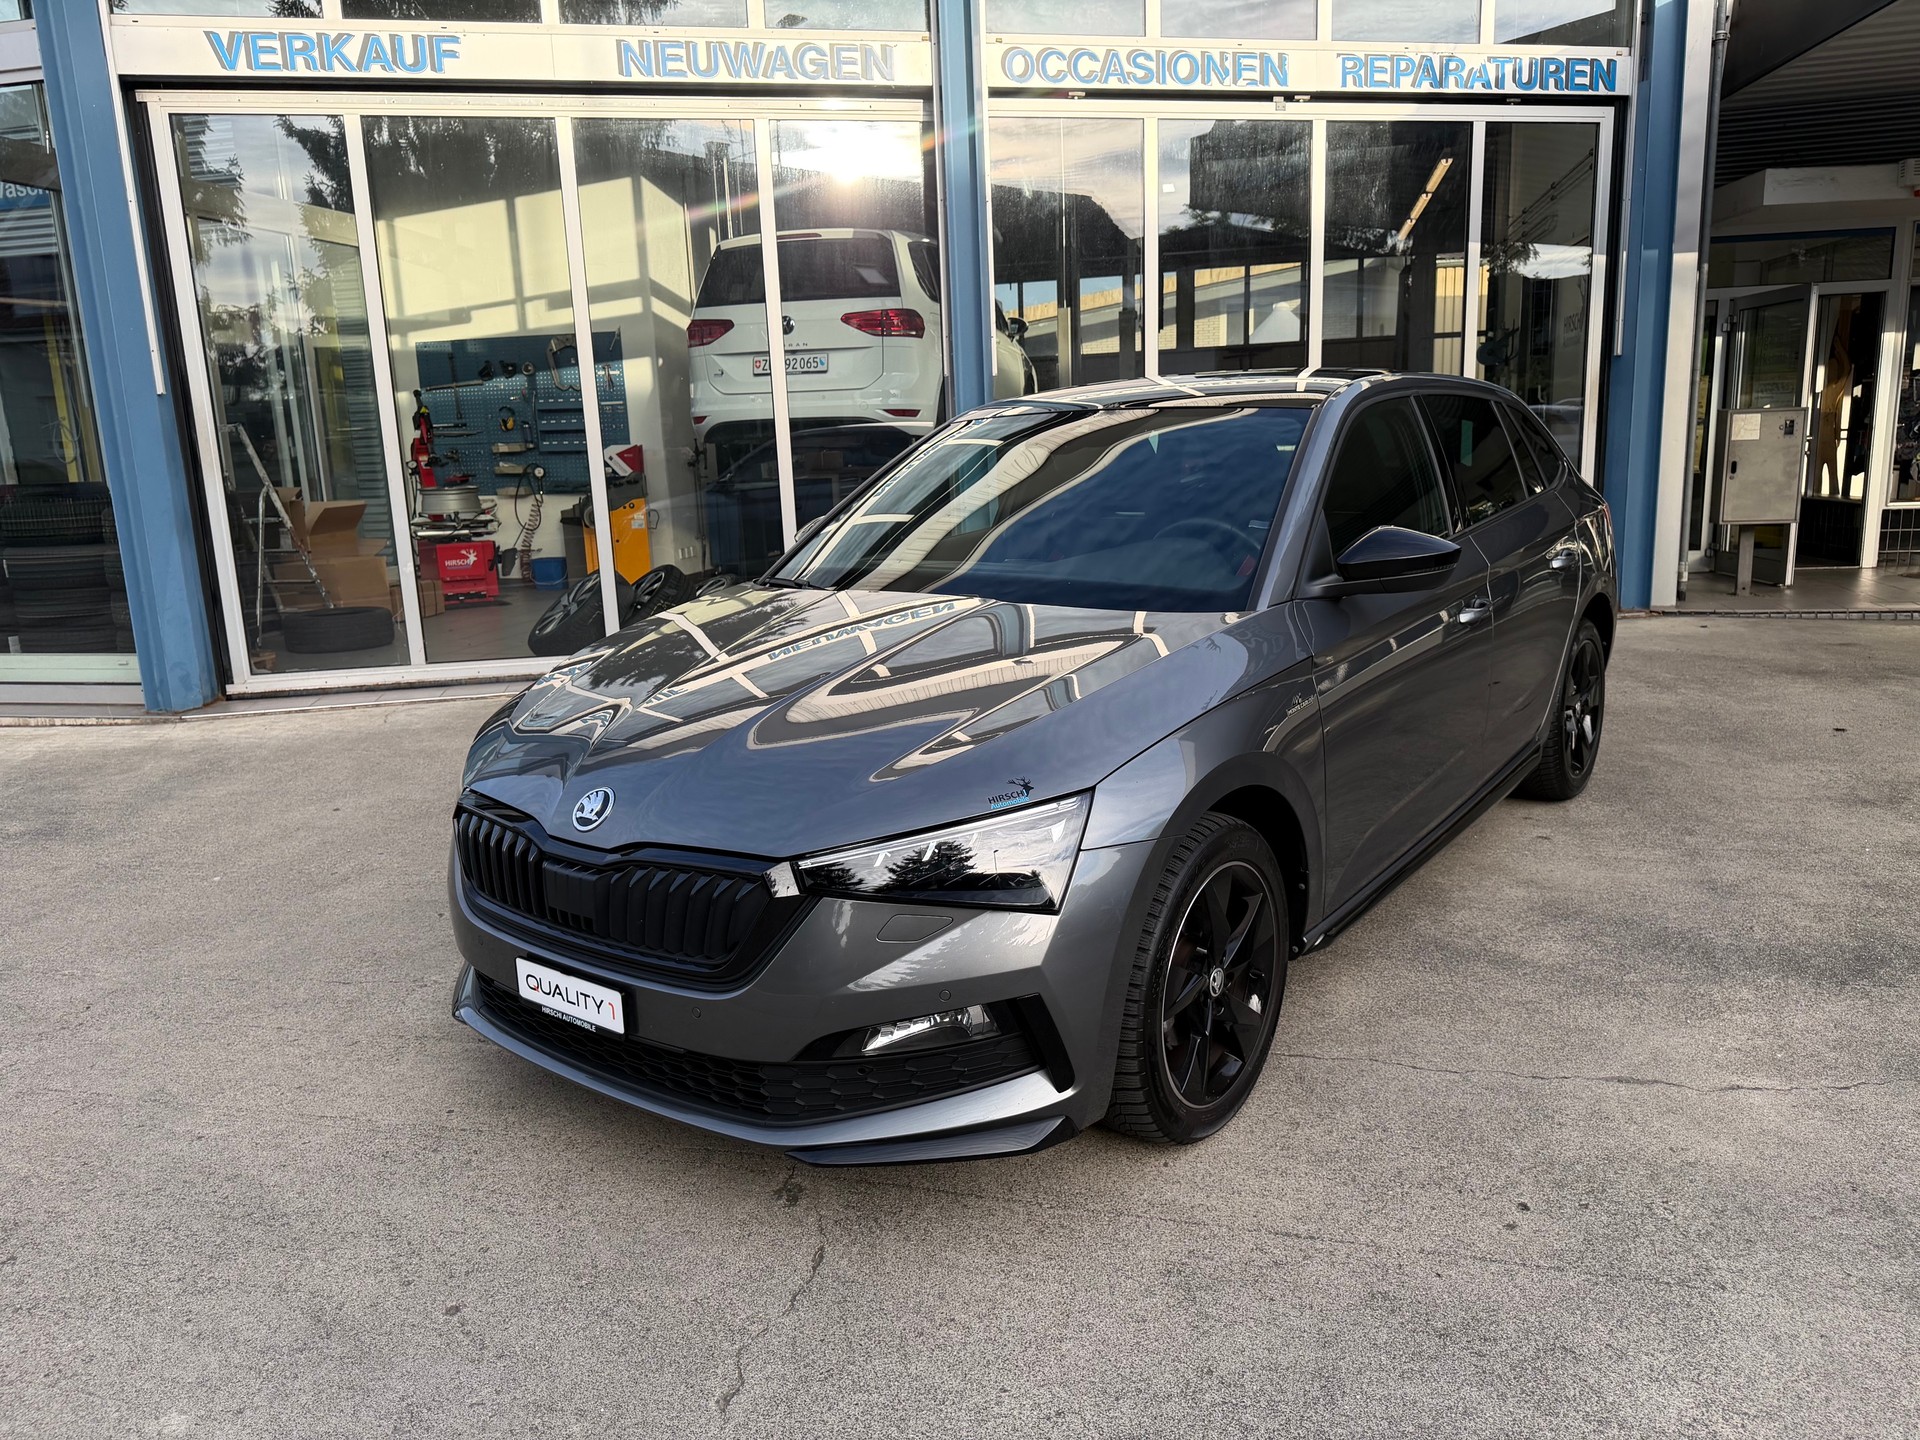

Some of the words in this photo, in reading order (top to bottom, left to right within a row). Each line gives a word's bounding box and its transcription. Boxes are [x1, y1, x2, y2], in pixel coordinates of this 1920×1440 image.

[203, 30, 461, 74] VERKAUF
[616, 39, 895, 81] NEUWAGEN
[1001, 46, 1289, 87] OCCASIONEN
[1336, 53, 1617, 92] REPARATUREN
[991, 796, 1029, 809] Automobile
[526, 974, 604, 1014] QUALITY
[608, 1002, 615, 1020] 1
[541, 1005, 562, 1019] HIRSCHI
[562, 1013, 596, 1033] AUTOMOBILE
